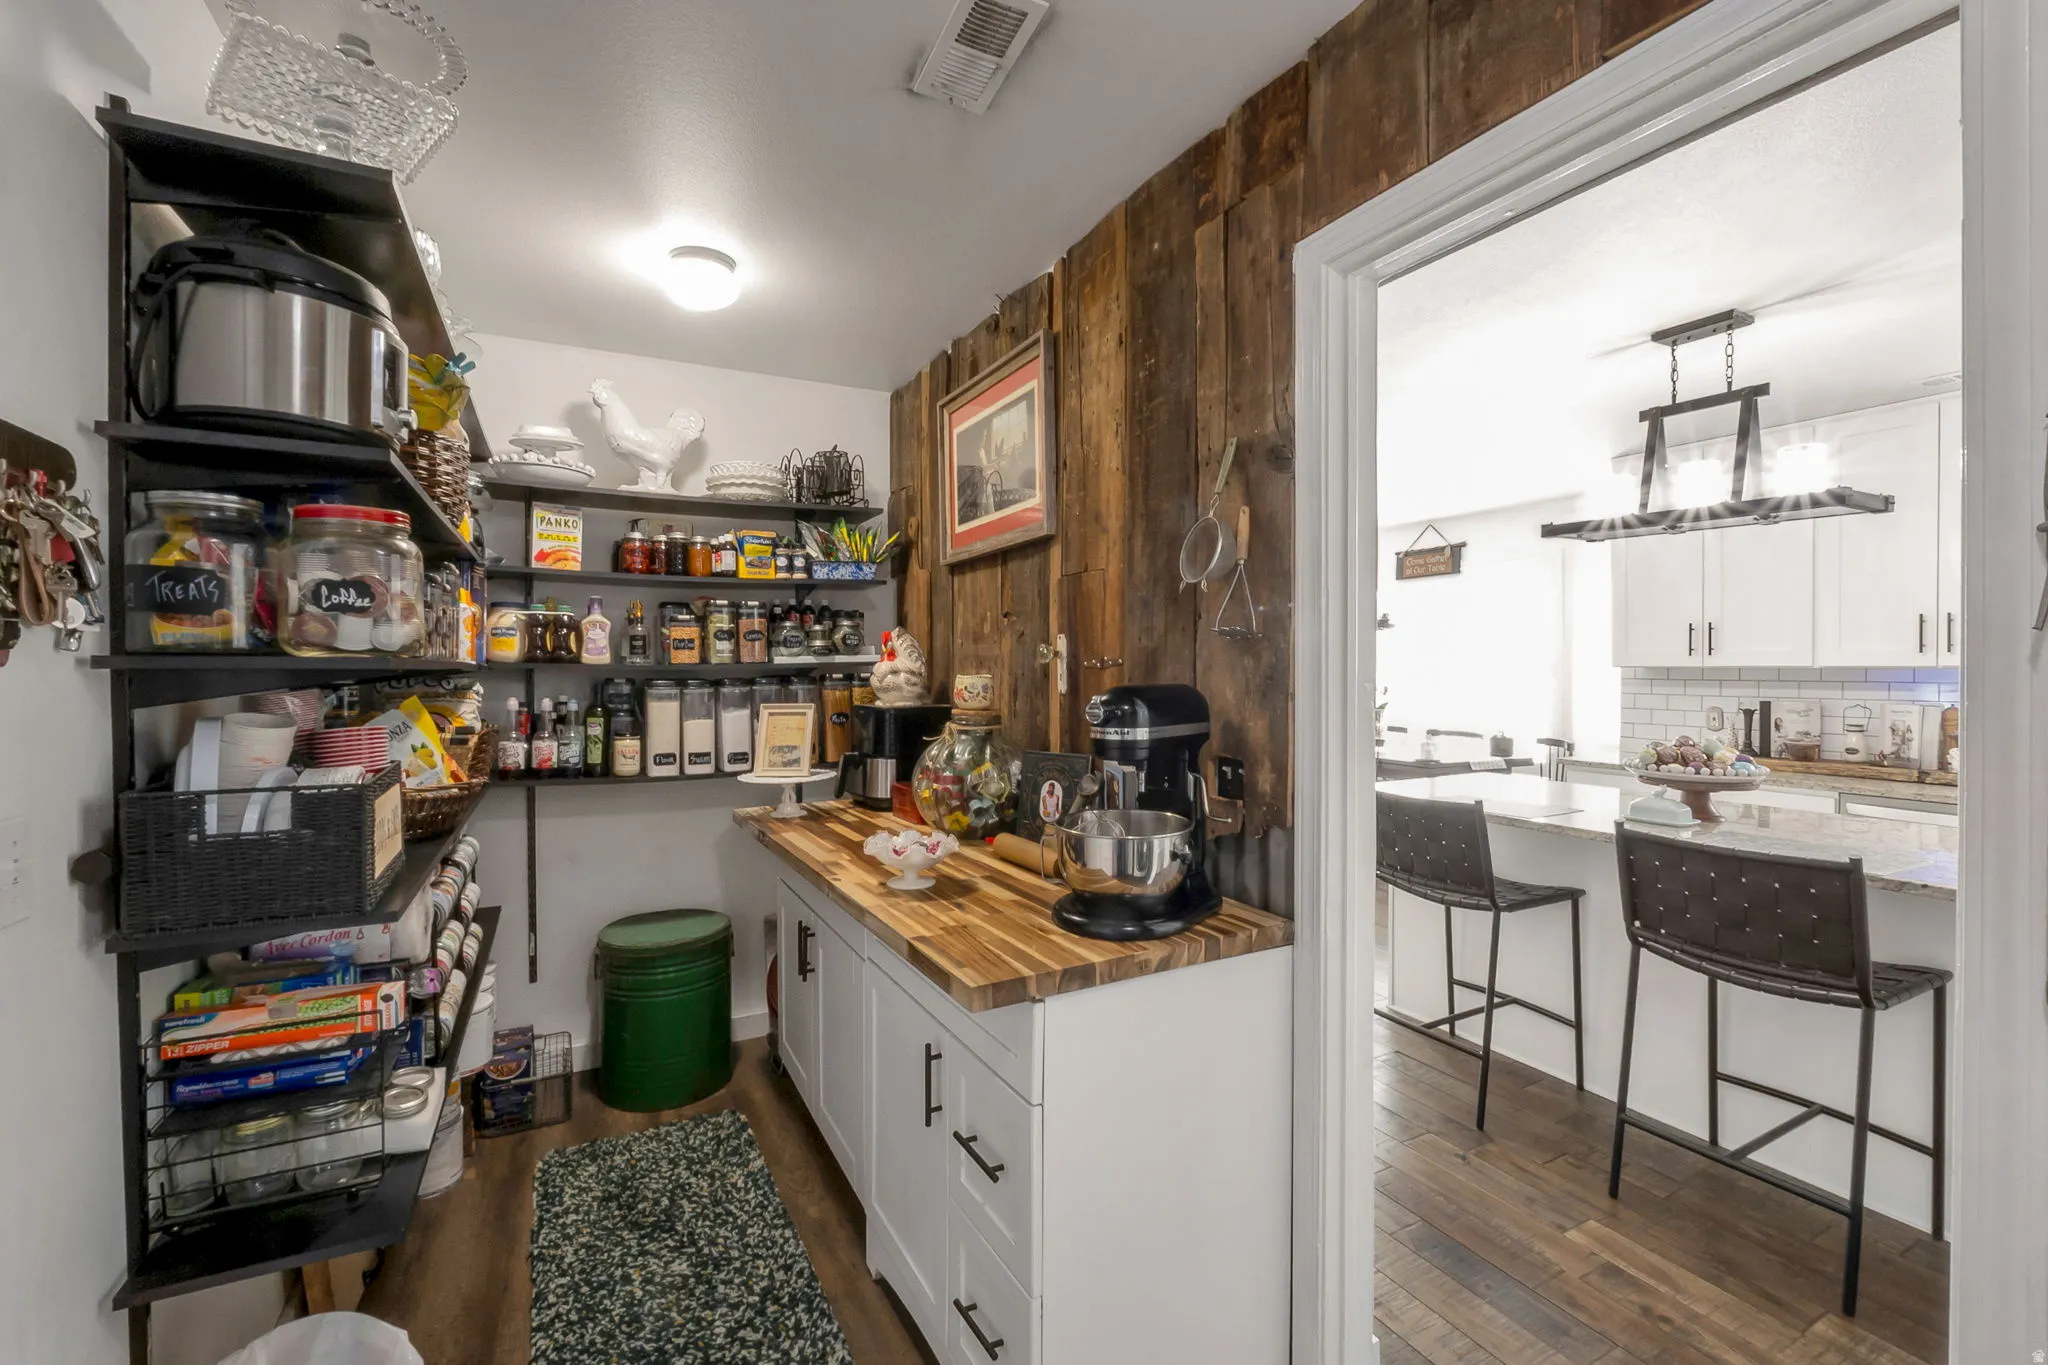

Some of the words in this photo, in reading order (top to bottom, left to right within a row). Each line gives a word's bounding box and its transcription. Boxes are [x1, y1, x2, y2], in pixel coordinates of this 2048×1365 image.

[540, 516, 579, 529] PANKO
[1413, 566, 1426, 575] Our
[321, 584, 372, 608] Coffee
[300, 929, 351, 949] Cordon
[363, 999, 373, 1027] STOAGE
[185, 1040, 230, 1053] ZIPPER
